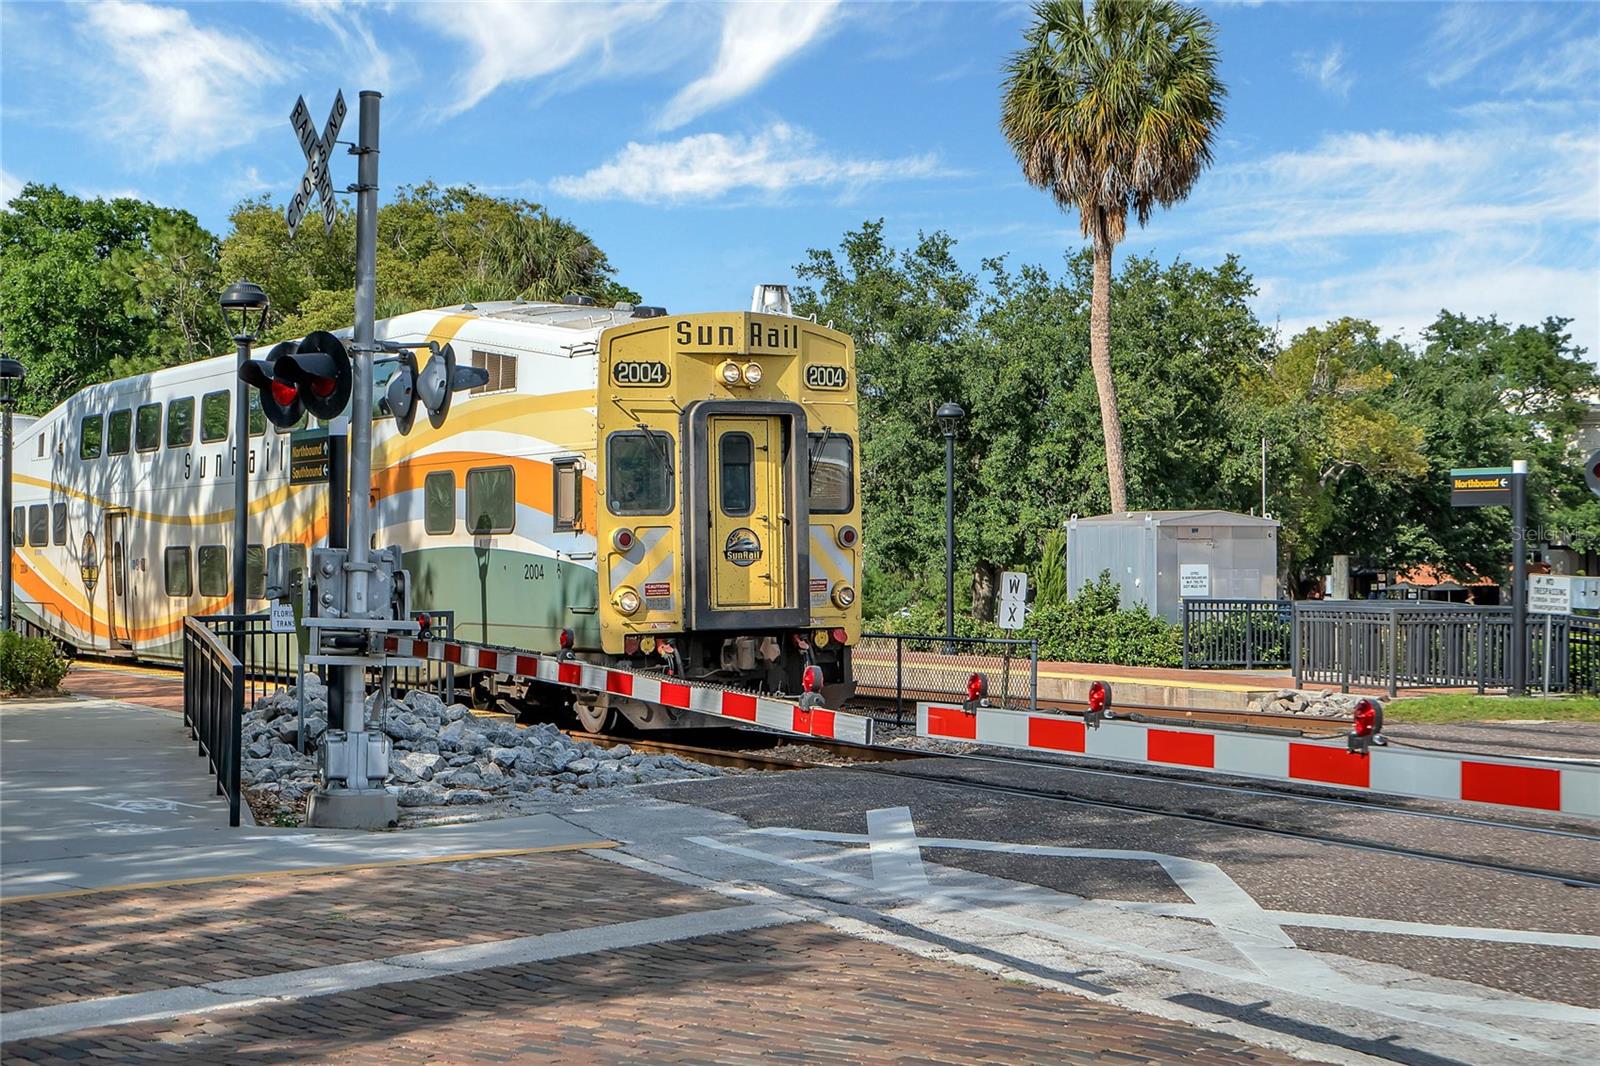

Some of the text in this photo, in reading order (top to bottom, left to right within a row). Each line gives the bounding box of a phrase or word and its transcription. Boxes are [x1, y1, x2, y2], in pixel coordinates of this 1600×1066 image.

[287, 98, 344, 228] CROSSING
[618, 362, 663, 383] 2004
[809, 366, 844, 387] 2004
[292, 443, 322, 458] Northbound
[291, 464, 322, 479] Southbound
[1454, 478, 1499, 488] Northbound
[727, 550, 761, 560] SunRail
[523, 563, 544, 580] 2004
[1009, 579, 1020, 594] W
[1008, 607, 1018, 622] X
